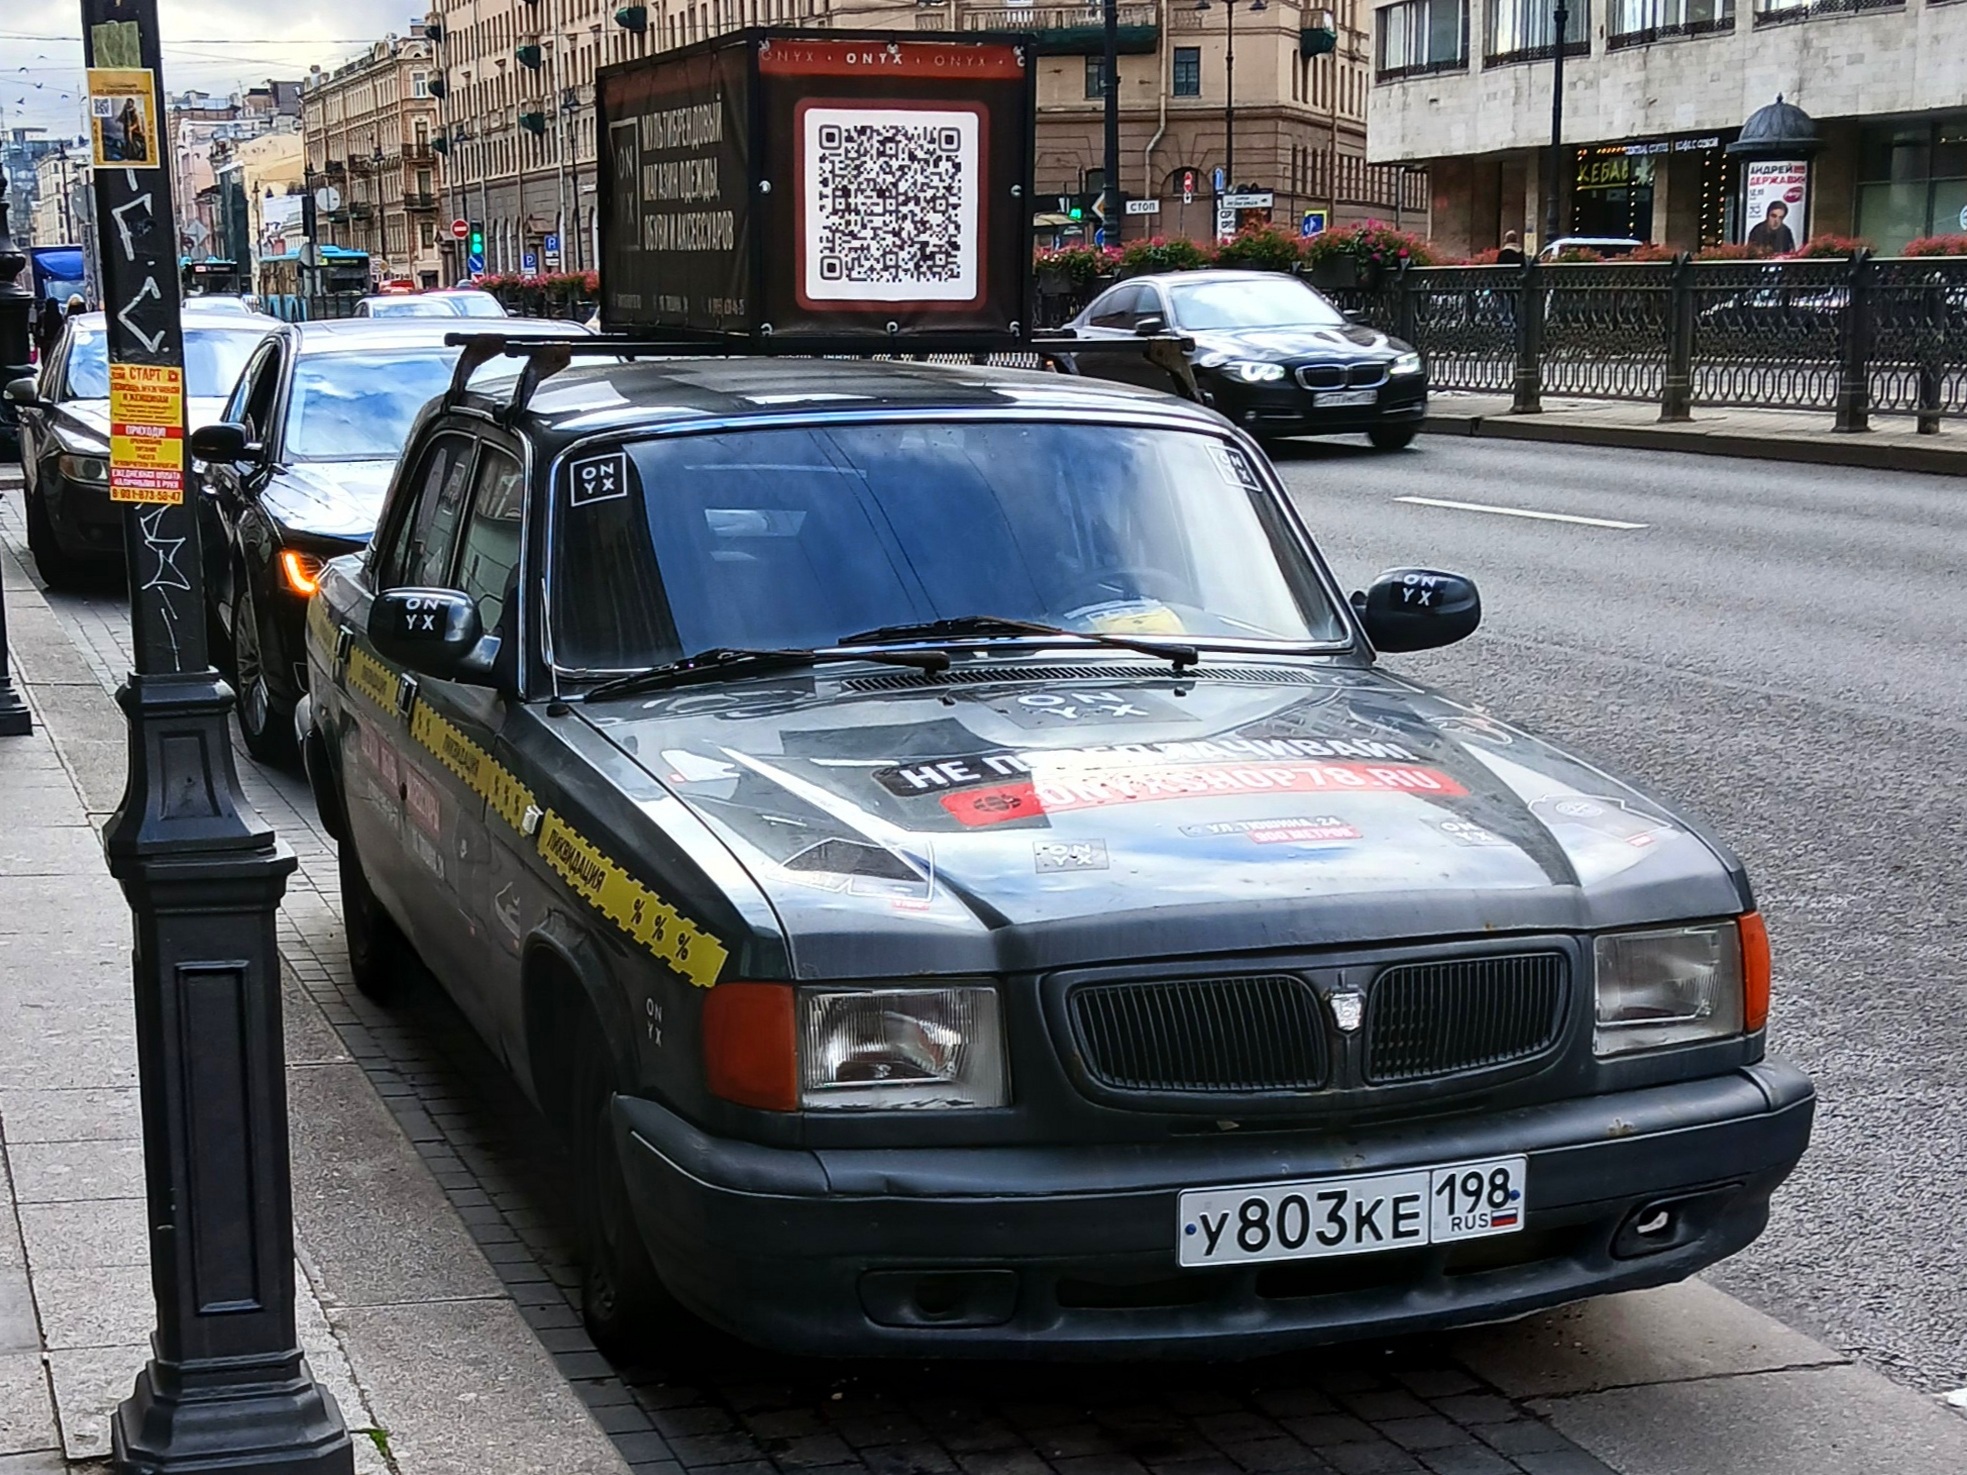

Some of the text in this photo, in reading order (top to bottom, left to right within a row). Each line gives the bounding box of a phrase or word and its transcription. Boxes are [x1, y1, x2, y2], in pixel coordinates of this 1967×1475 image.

[846, 53, 902, 65] ONYX
[934, 55, 985, 67] ONYX
[642, 93, 722, 151] МУЛЬТИБРЕНДОВЫЙ
[618, 145, 633, 179] ON
[1750, 163, 1792, 174] АНДРЕЙ
[644, 157, 720, 203] МАГАЗИН ОДЕЖДЫ,
[644, 210, 734, 251] ОБУВИ И АКСЕССУАРОВ
[130, 367, 162, 381] СТАРТ
[1219, 451, 1245, 469] ON
[582, 463, 614, 479] ON
[1228, 468, 1250, 482] YX
[584, 477, 615, 494] YX
[1403, 573, 1436, 587] ON
[406, 598, 439, 610] ON
[1403, 587, 1432, 606] YX
[406, 614, 435, 630] YX
[1017, 692, 1125, 706] ON
[1039, 704, 1150, 719] YX
[899, 761, 982, 789] НЕ
[1454, 831, 1494, 841] YX
[1051, 843, 1093, 854] ON
[547, 829, 607, 893] ЛИКВИДАЦИЯ
[1052, 854, 1094, 866] YX
[646, 998, 662, 1022] ON
[648, 1021, 662, 1047] YX
[1200, 1167, 1511, 1256] У803КЕ 198
[1451, 1213, 1489, 1232] RUS
